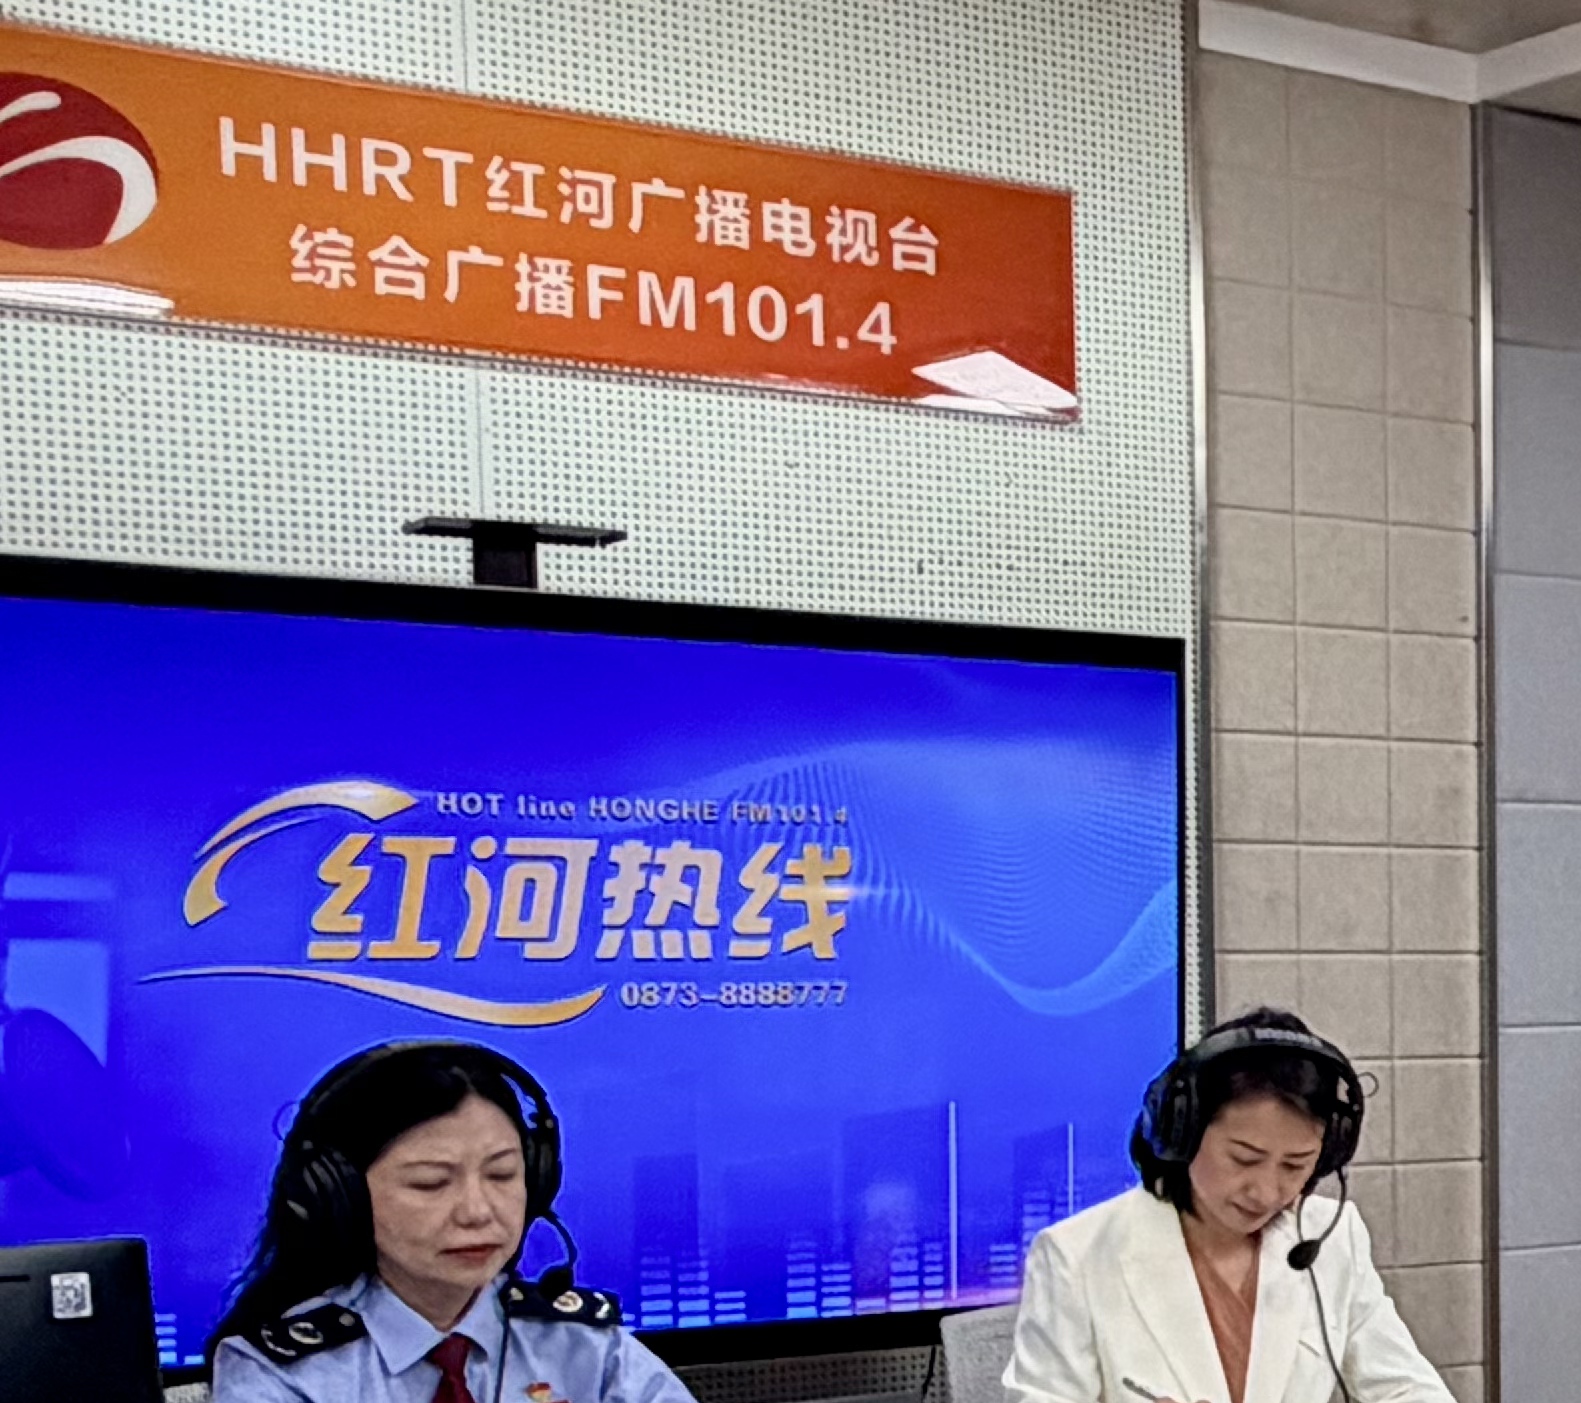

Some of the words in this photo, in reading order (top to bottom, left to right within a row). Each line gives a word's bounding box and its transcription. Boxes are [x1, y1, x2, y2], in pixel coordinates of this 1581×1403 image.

[218, 116, 940, 276] HHRT红河广播电视台
[289, 223, 898, 355] 综合广播FM101.4
[436, 792, 503, 817] HOT
[516, 796, 576, 820] line
[588, 797, 719, 823] HONGHE
[306, 831, 852, 961] 红河热线
[620, 981, 848, 1010] 0873-8888777
